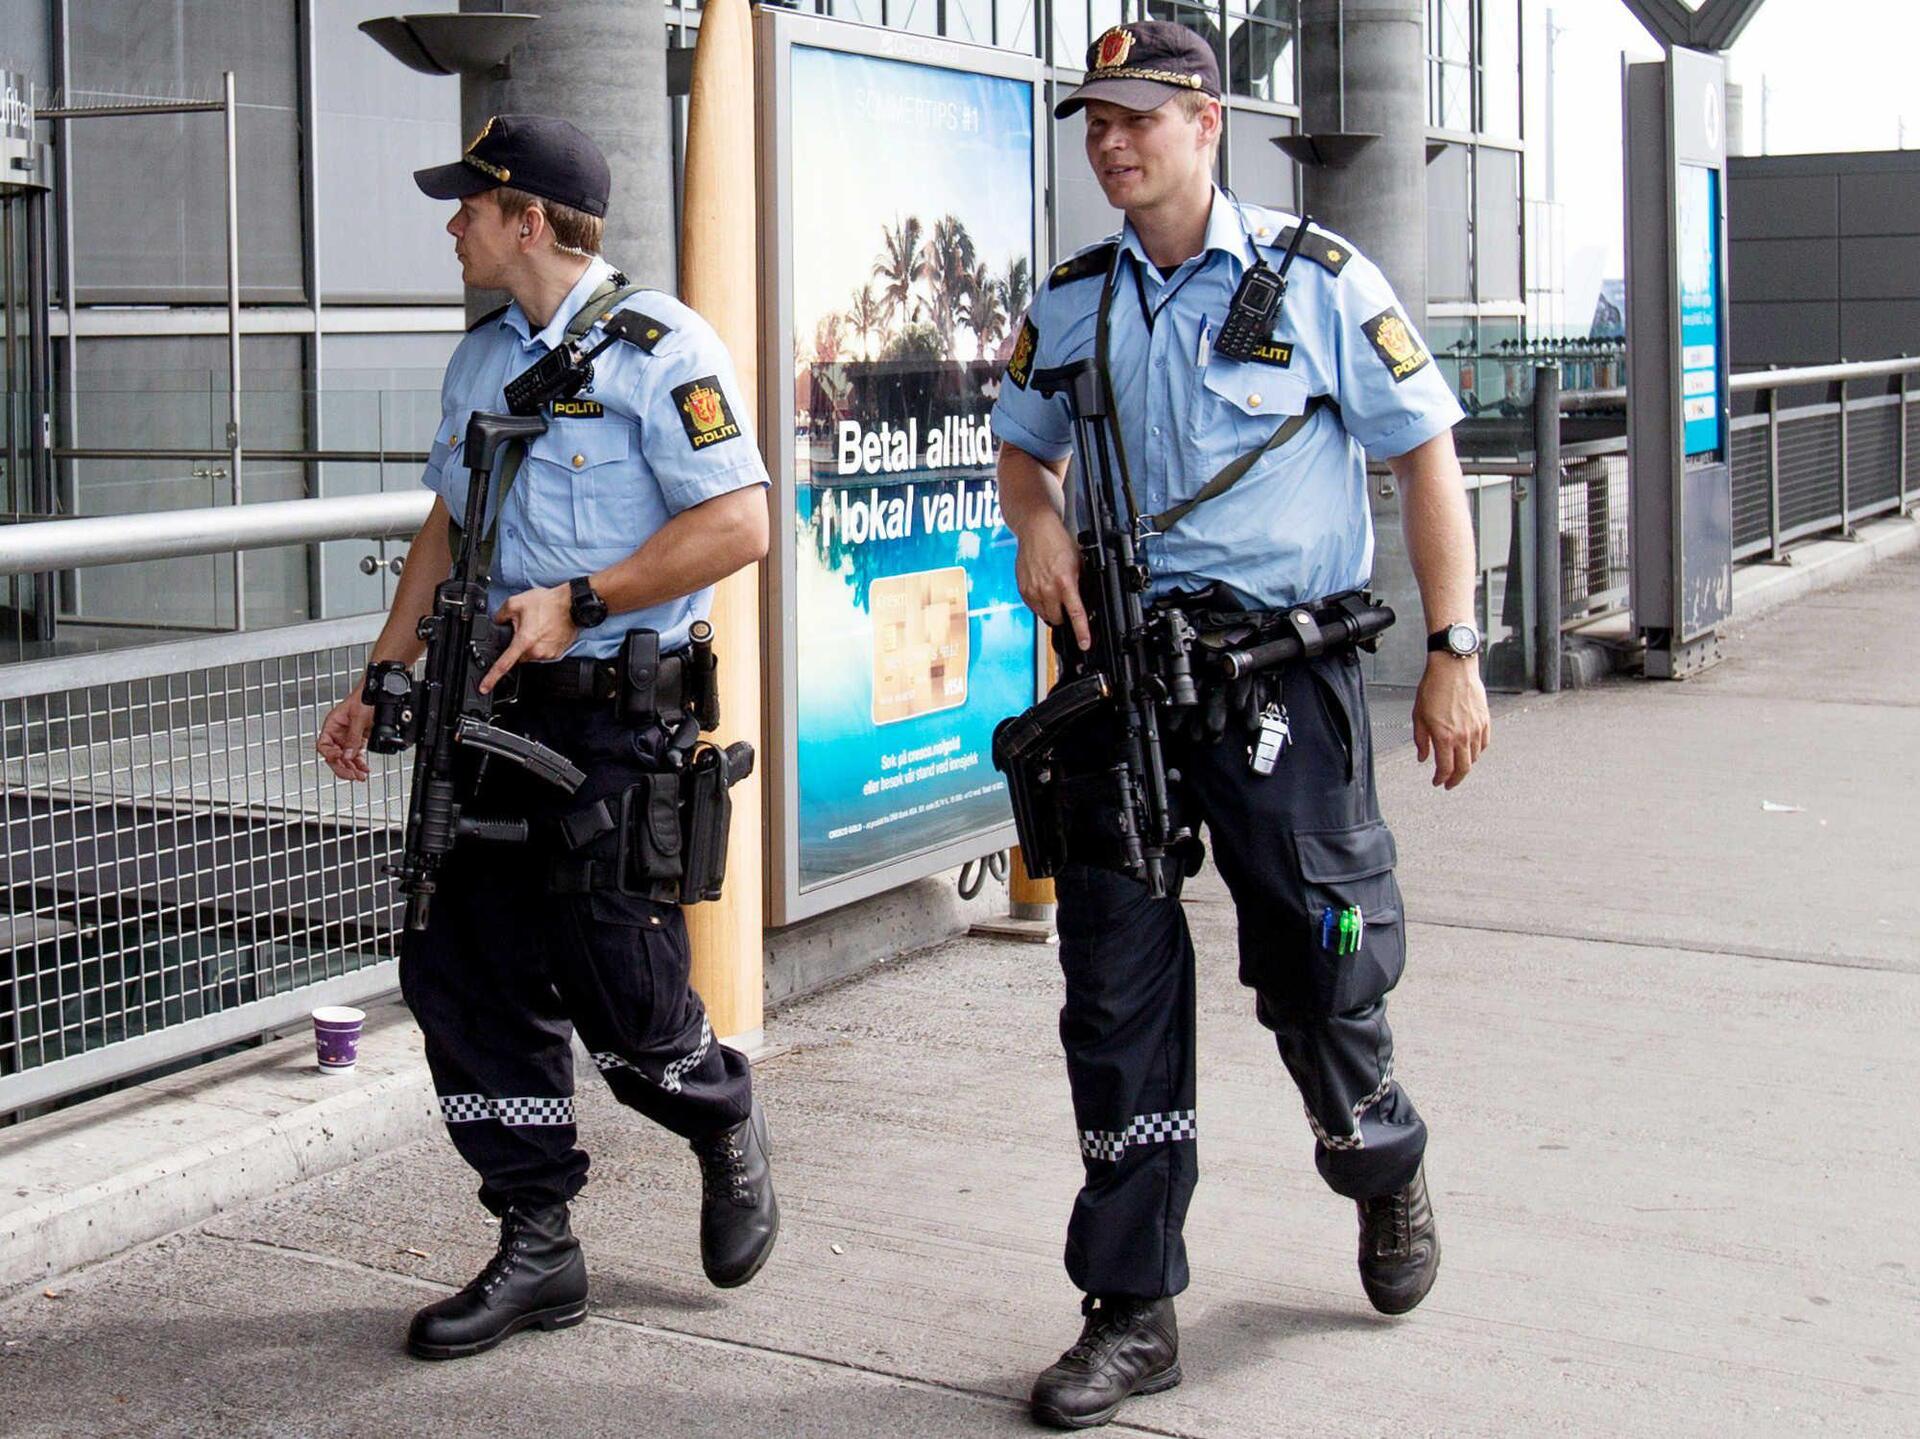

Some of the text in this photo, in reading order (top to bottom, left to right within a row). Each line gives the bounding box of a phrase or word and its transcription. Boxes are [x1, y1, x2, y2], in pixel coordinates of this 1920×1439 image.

[1392, 350, 1427, 378] POLITI
[554, 401, 601, 415] POLITI
[693, 423, 738, 447] POLITI
[838, 413, 994, 475] Betal alltid
[840, 485, 914, 545] lokal
